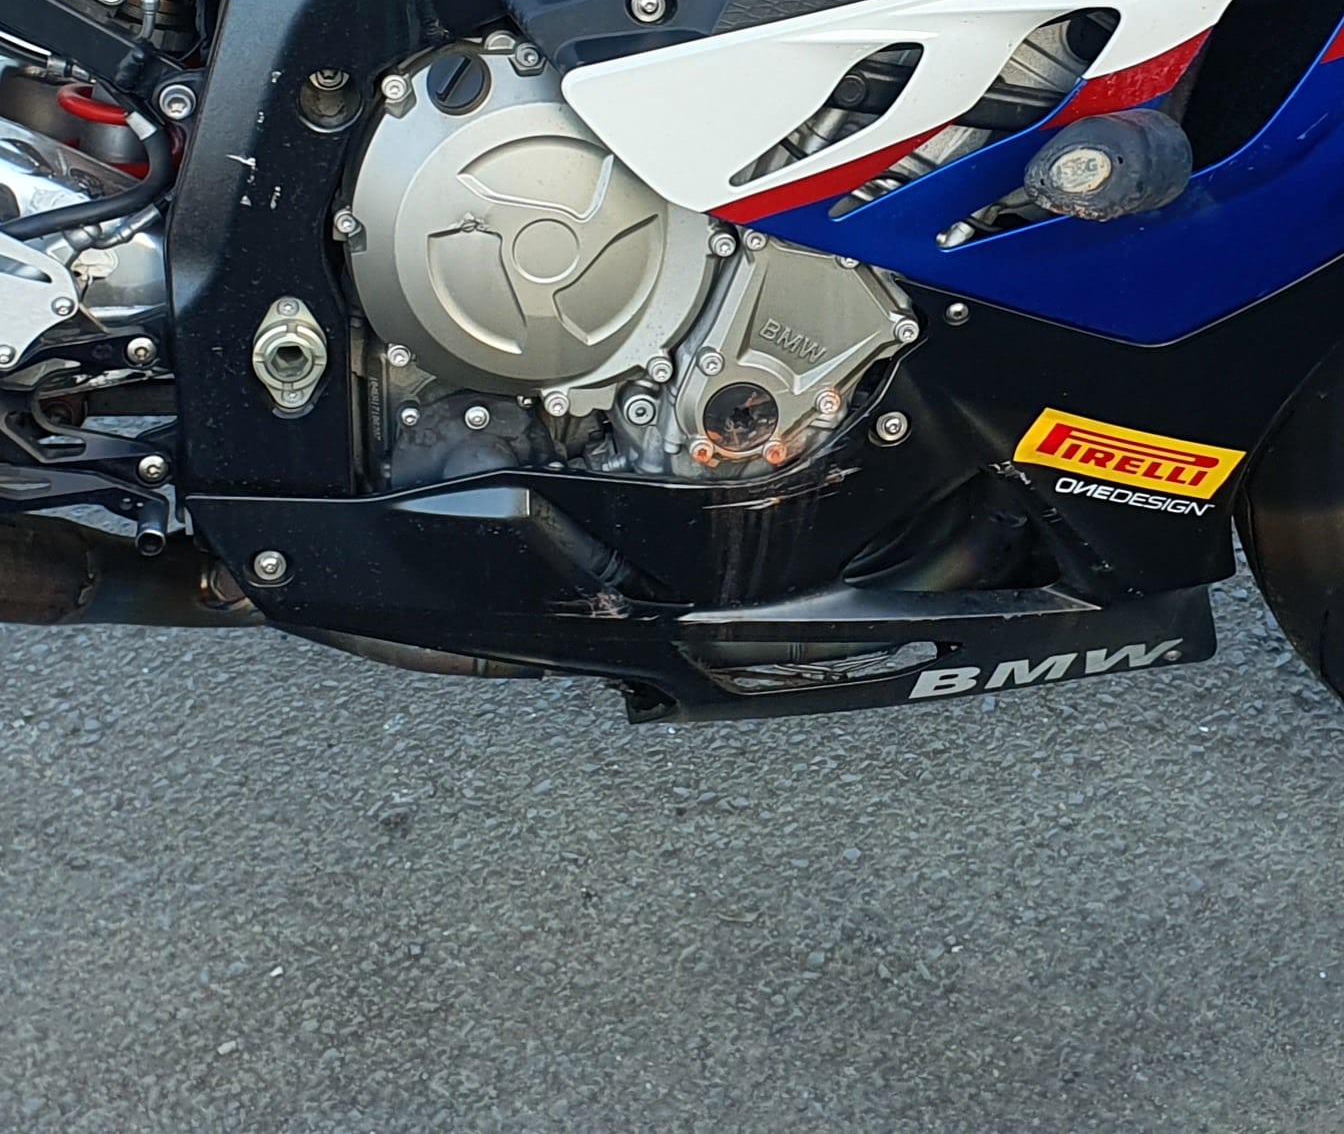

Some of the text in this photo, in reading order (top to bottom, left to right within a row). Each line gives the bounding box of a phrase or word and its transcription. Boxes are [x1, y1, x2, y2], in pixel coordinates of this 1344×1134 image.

[759, 318, 826, 364] BMW
[1036, 422, 1220, 487] PIRELLI
[908, 638, 1184, 700] BMW
